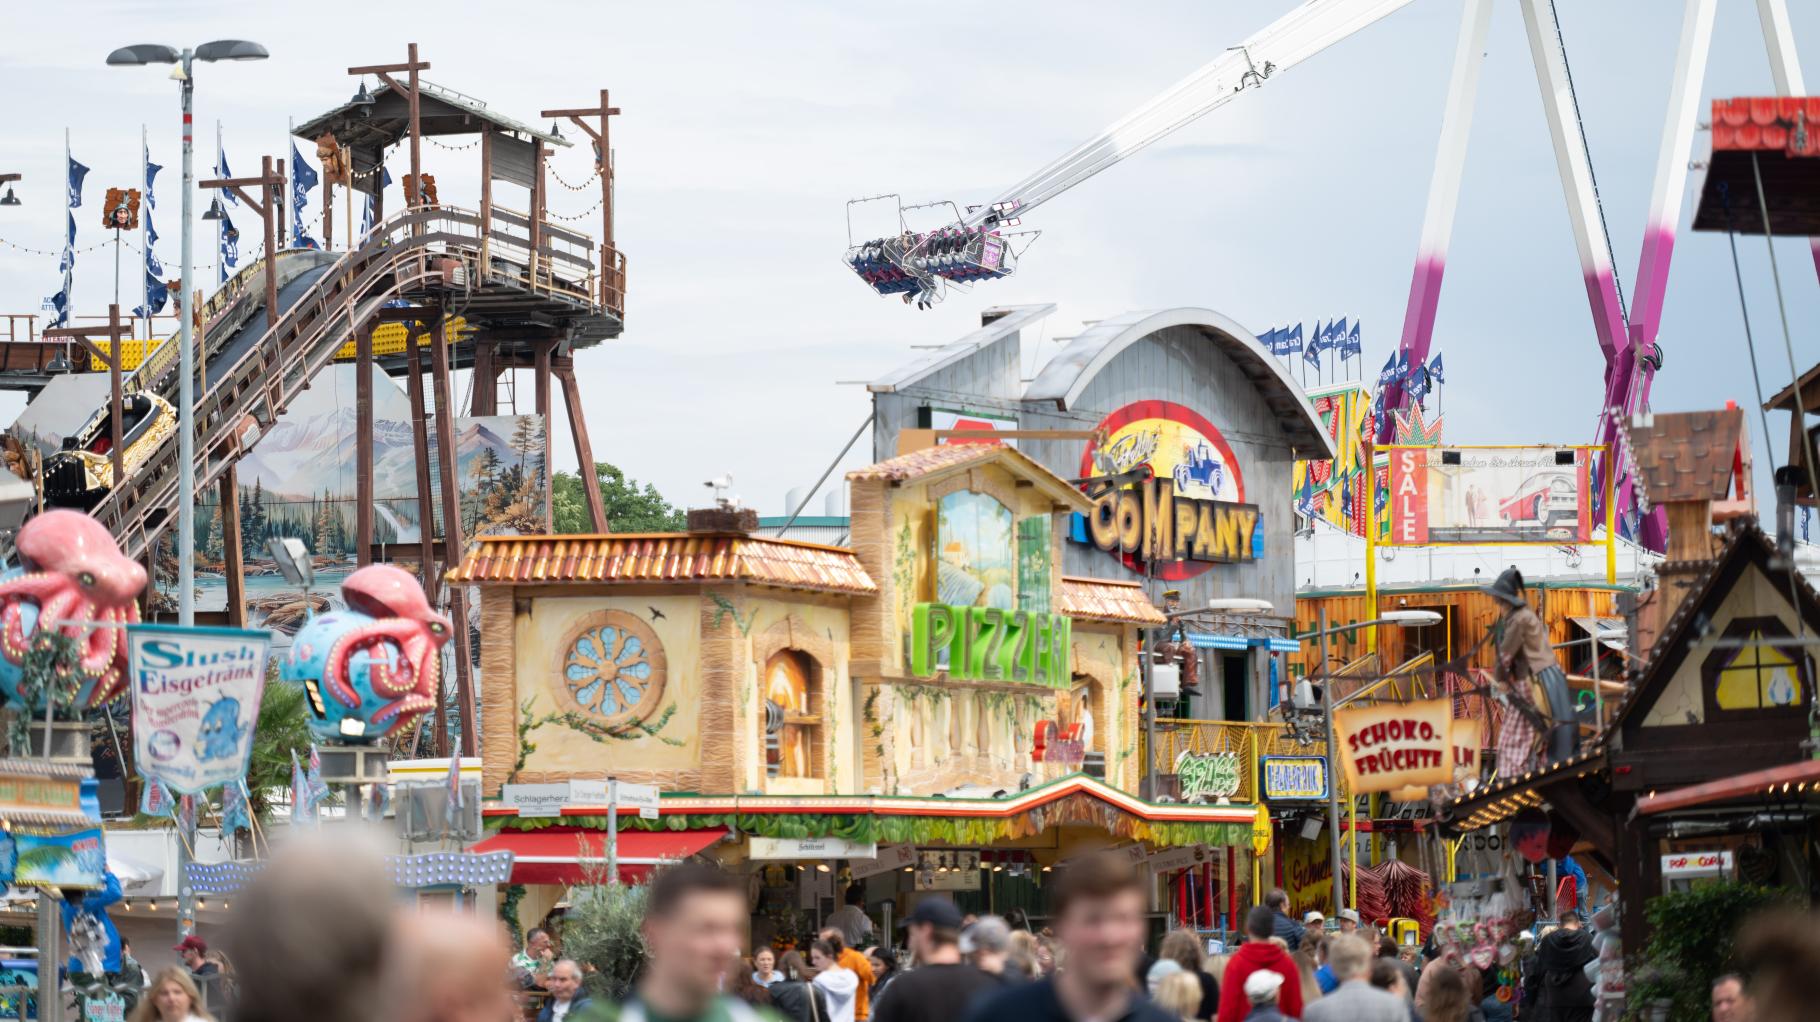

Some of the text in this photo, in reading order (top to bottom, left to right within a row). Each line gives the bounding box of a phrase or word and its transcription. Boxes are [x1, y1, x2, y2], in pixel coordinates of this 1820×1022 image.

[1399, 450, 1418, 541] SALE
[1090, 479, 1258, 561] COMPANY
[140, 640, 254, 669] Slush
[139, 664, 255, 696] Eisgetränk
[1354, 748, 1443, 776] FRÜCHTE
[514, 794, 569, 806] Schlagerherz
[1669, 857, 1688, 869] POP
